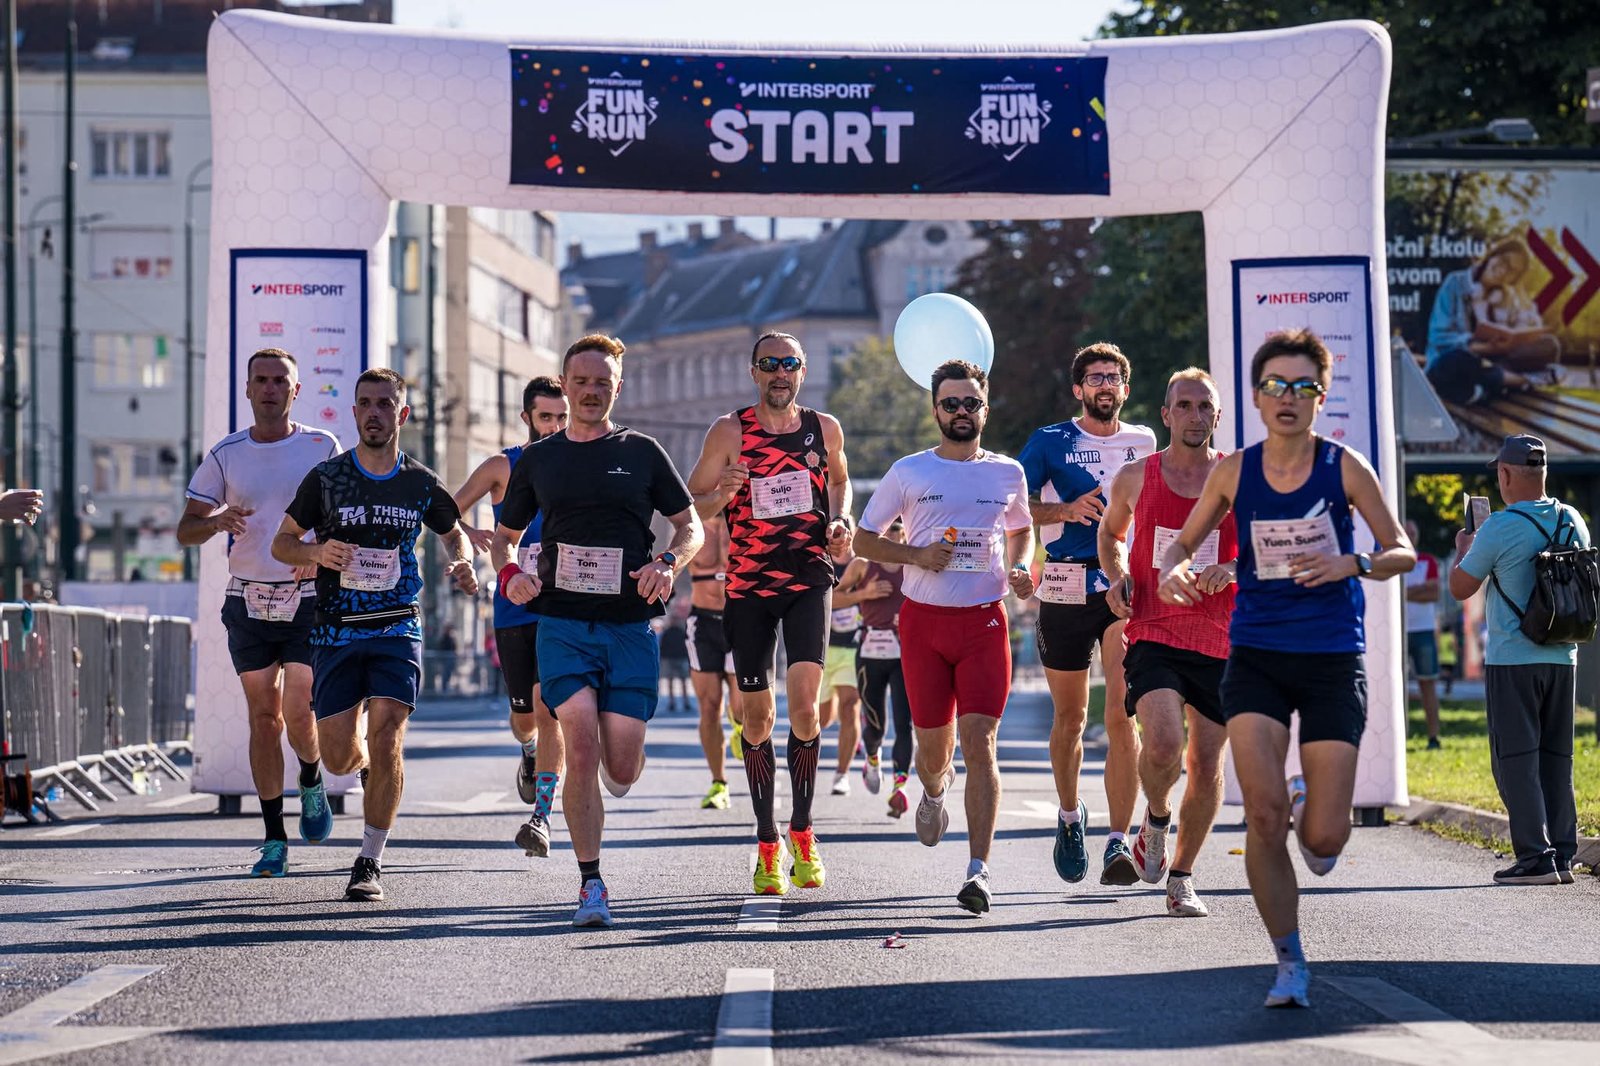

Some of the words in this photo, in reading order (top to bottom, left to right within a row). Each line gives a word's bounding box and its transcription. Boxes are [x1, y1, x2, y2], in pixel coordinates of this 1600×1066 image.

[758, 83, 871, 98] INTERSPORT
[588, 88, 644, 114] FUN
[981, 92, 1038, 119] FUN
[587, 112, 646, 141] RUN
[981, 118, 1040, 145] RUN
[708, 109, 914, 163] START
[1388, 267, 1441, 285] svom
[264, 284, 344, 296] INTERSPORT
[1269, 292, 1350, 304] INTERSPORT
[1065, 450, 1101, 464] MAHIR
[770, 485, 792, 495] Suljo
[372, 504, 418, 521] THERM
[372, 516, 417, 529] MASTER
[1263, 537, 1292, 548] Yuen
[1295, 533, 1326, 546] Suen
[360, 559, 388, 569] Velmir
[577, 558, 598, 568] Tom
[1044, 573, 1069, 582] Mahir
